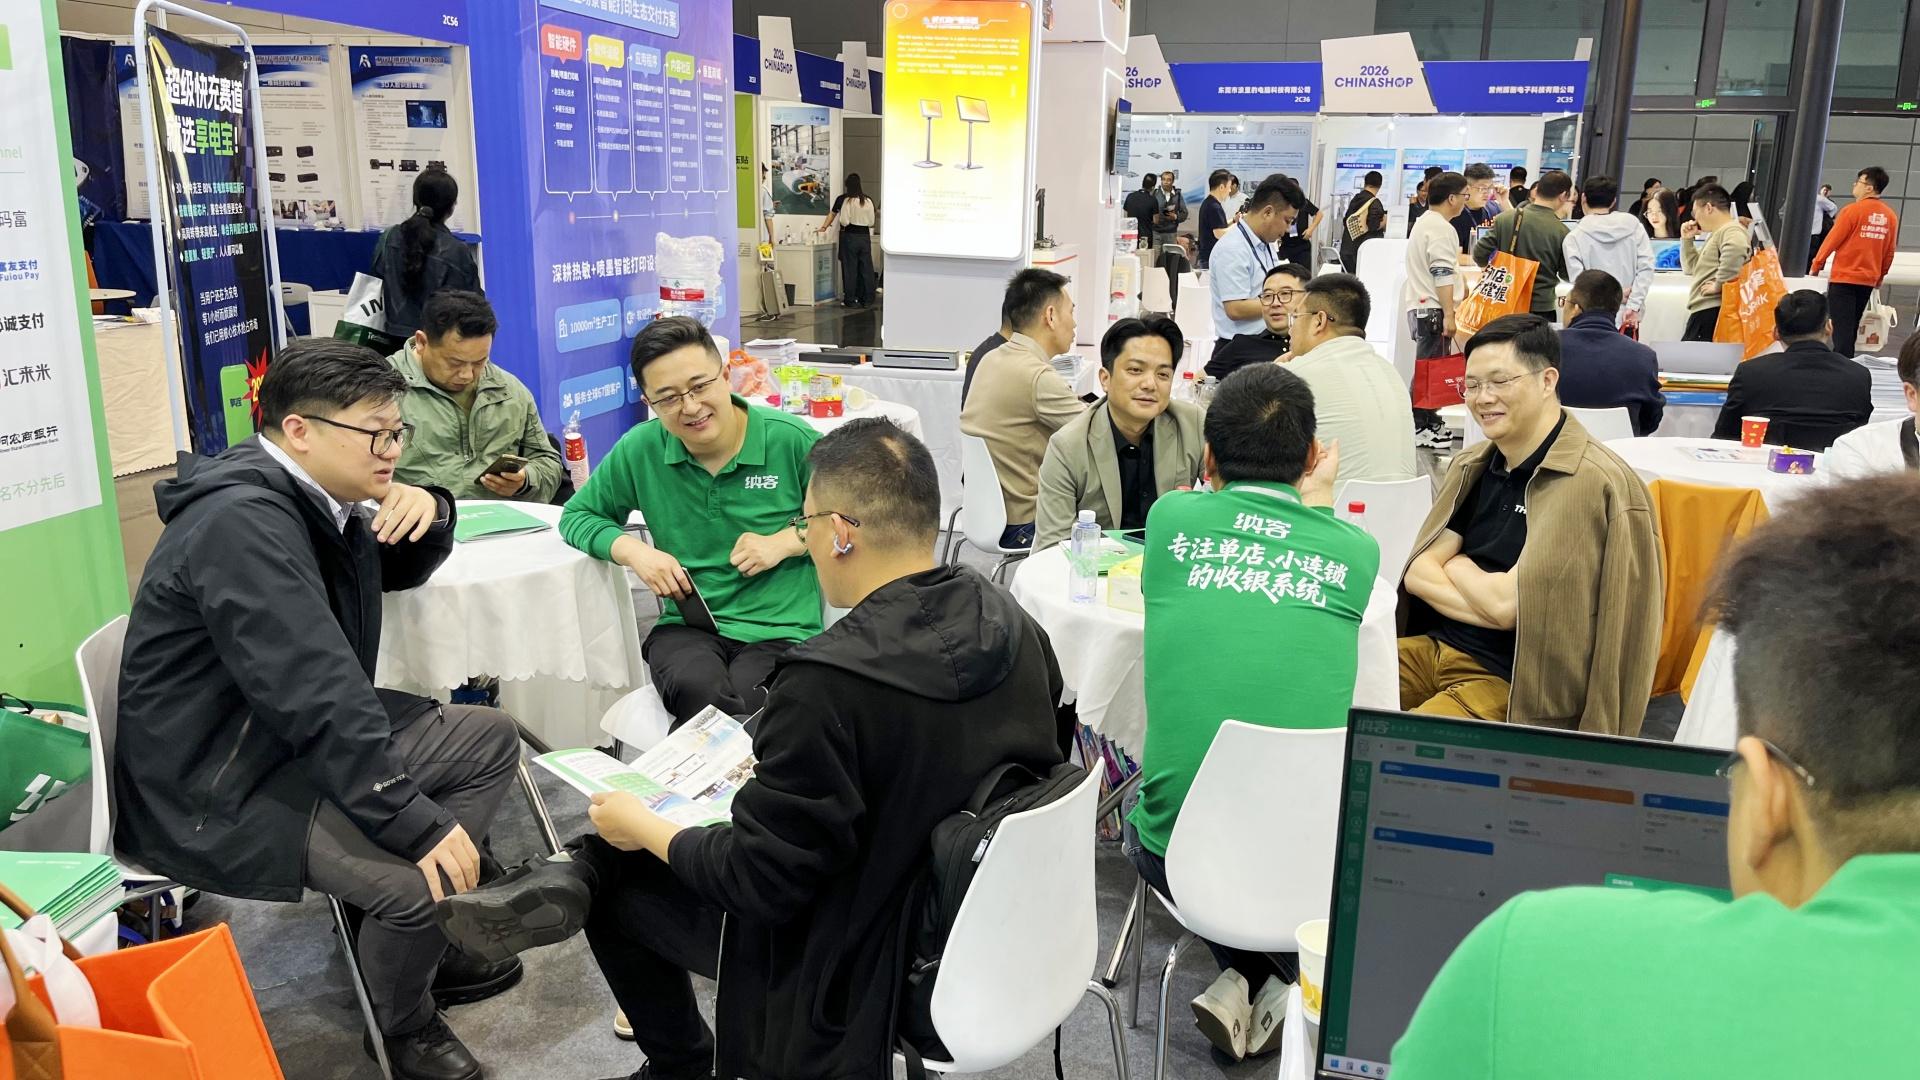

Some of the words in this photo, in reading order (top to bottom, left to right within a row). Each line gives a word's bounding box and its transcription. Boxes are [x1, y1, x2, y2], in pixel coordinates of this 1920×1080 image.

[442, 15, 459, 27] 2C56
[547, 33, 577, 53] 智能硬件
[773, 48, 785, 60] 2026
[764, 58, 793, 75] CHINASHOP
[1125, 66, 1139, 77] 26
[1359, 65, 1390, 76] 2026
[845, 76, 867, 91] CHINASHOP
[1334, 76, 1414, 88] CHINASHOP
[165, 66, 243, 115] 超级快充赛道
[1556, 96, 1574, 104] 2C35
[25, 271, 40, 281] Pay
[552, 253, 658, 284] 深耕热敏+喷墨智能打印设
[3, 363, 52, 387] 汇来米
[0, 472, 65, 501] 名不分先后
[744, 474, 779, 489] 纳客
[1232, 512, 1292, 539] 纳客
[1167, 532, 1349, 590] 专注单店、小连锁
[1186, 563, 1327, 608] 的收银系统
